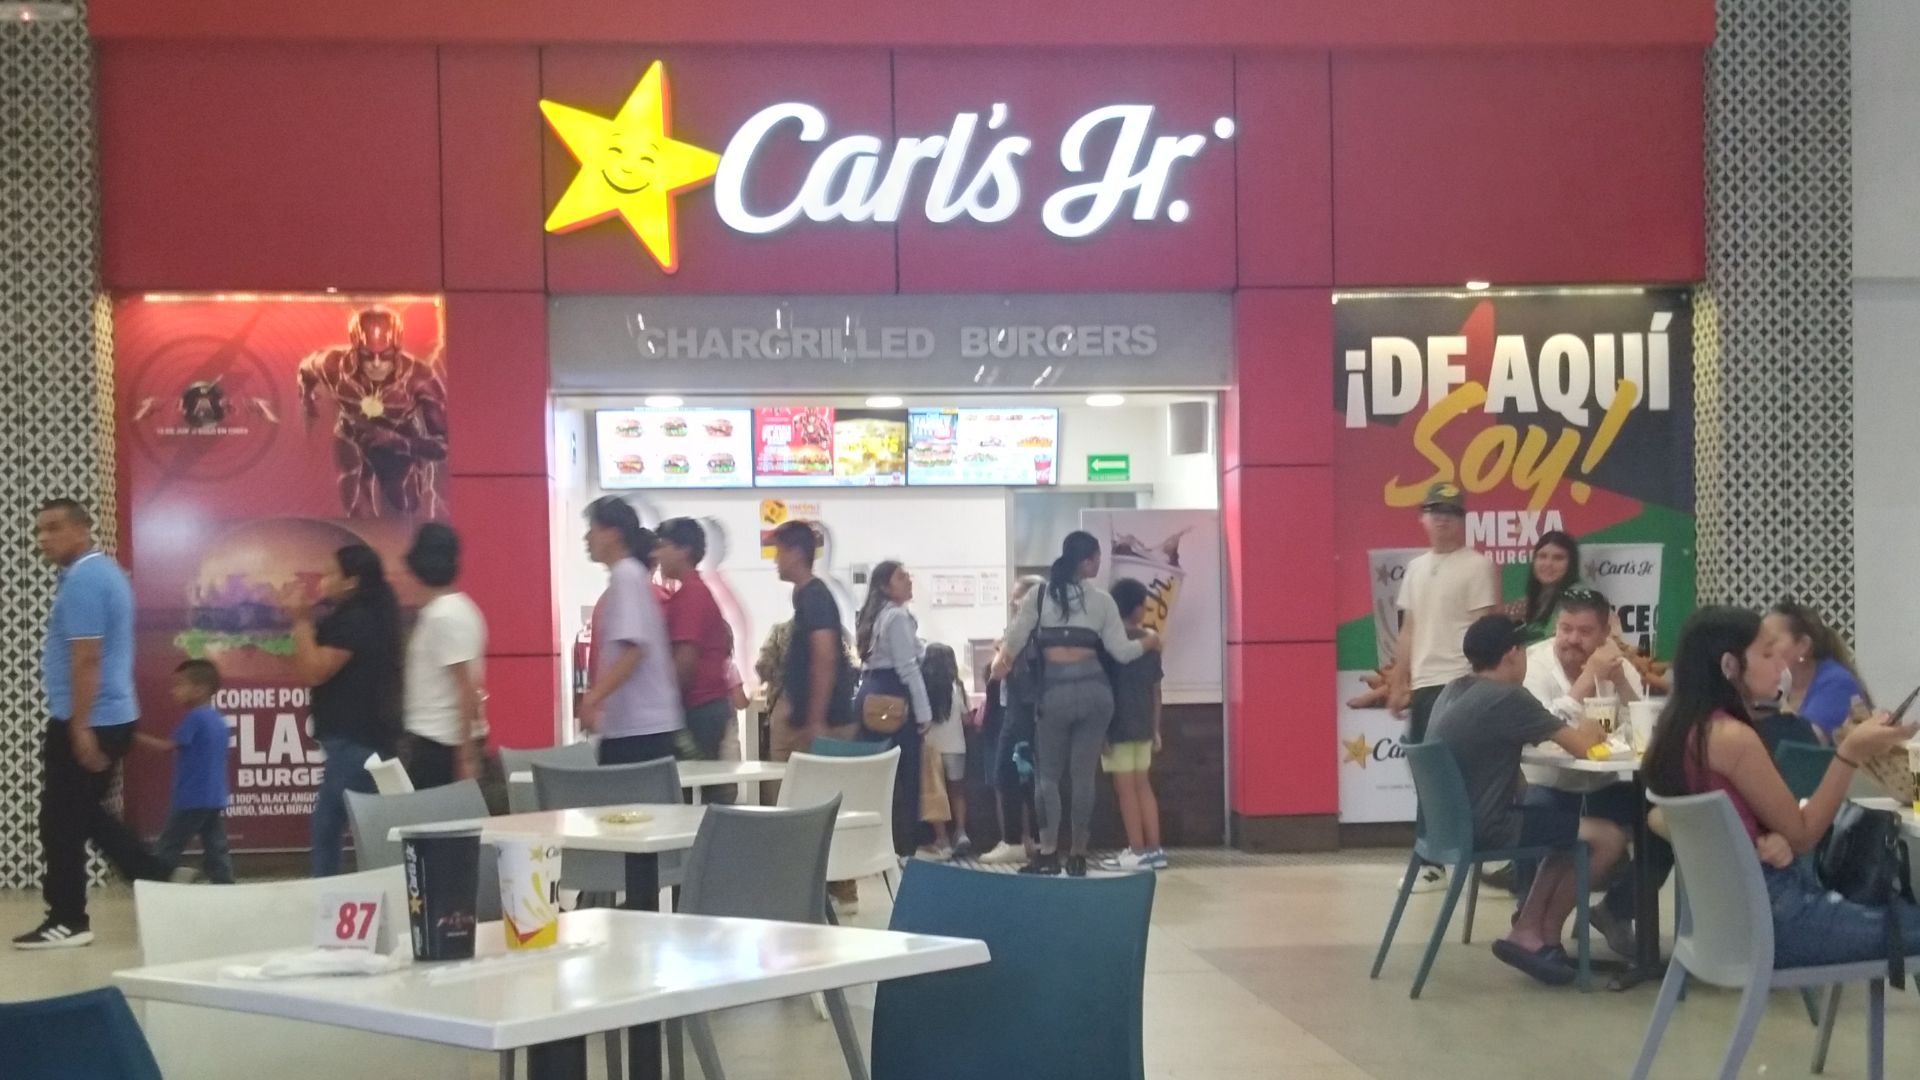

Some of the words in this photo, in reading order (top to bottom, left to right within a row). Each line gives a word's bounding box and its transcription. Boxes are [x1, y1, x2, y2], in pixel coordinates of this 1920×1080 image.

[714, 102, 1031, 234] Carl's
[1042, 104, 1206, 238] Jr.
[637, 326, 935, 360] CHARGRILLED
[960, 324, 1158, 358] BURGERS
[1483, 311, 1673, 427] AQUÍ
[1384, 378, 1638, 513] Soy!
[236, 793, 261, 805] 100%
[261, 792, 290, 804] BLACK
[258, 803, 286, 816] SALSA
[336, 902, 377, 940] 87
